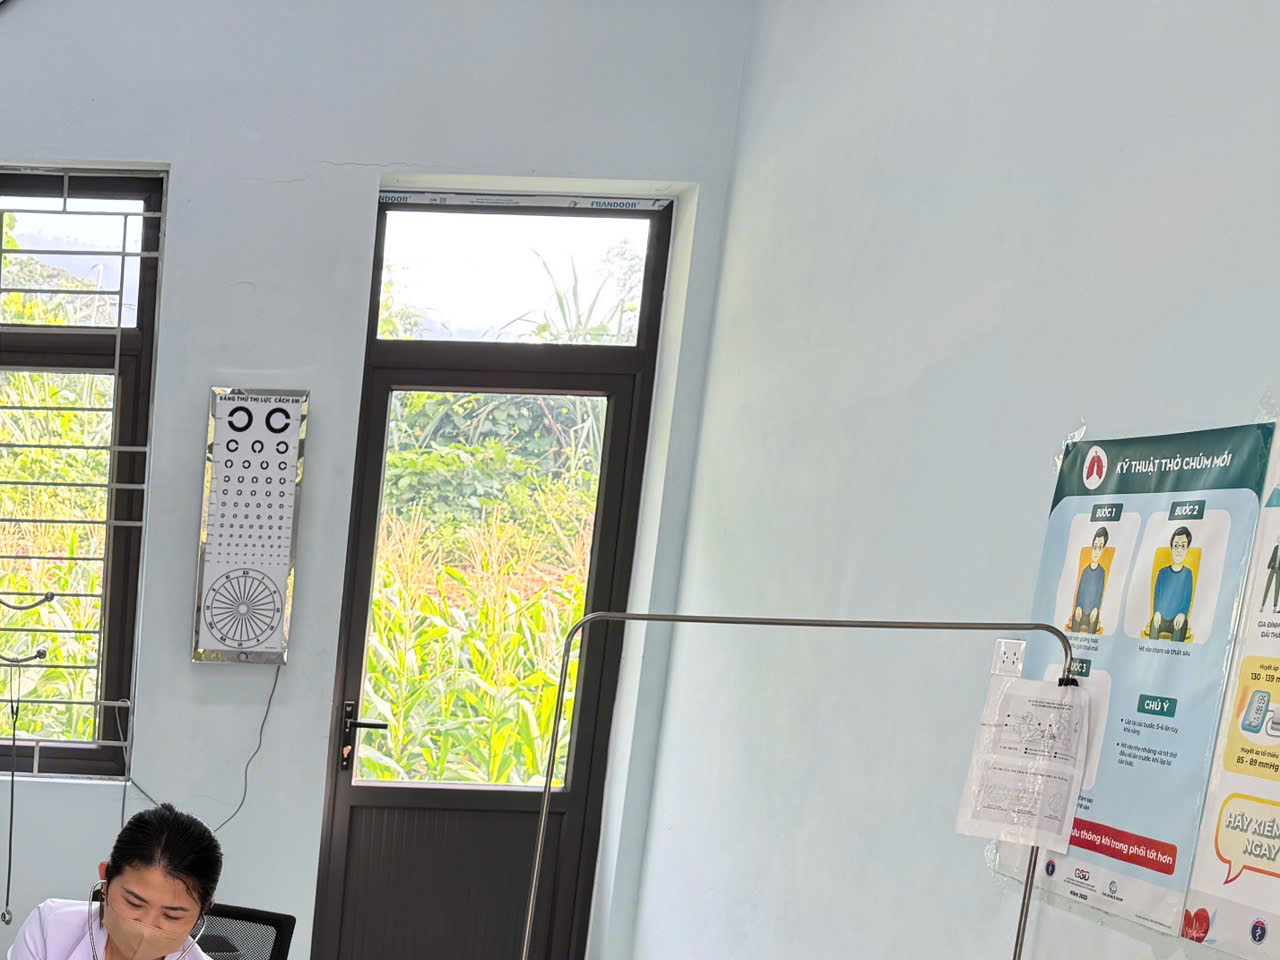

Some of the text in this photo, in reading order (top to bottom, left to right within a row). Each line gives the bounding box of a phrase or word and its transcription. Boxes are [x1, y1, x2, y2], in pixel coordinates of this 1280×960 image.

[591, 200, 637, 209] FRANDOOR
[274, 396, 290, 404] CÁCH
[1116, 458, 1130, 474] KỸ
[1131, 456, 1160, 476] THUẬT
[1161, 453, 1182, 472] THỞ
[1183, 452, 1213, 470] CHÚM
[1193, 505, 1199, 515] 2
[1070, 661, 1083, 672] ƯỚC
[1251, 672, 1261, 681] 130
[1265, 673, 1275, 683] 139
[1144, 698, 1170, 712] CHÚ Ý
[1237, 755, 1244, 764] 85
[1250, 757, 1257, 767] 89
[1258, 760, 1280, 772] mmHg
[1225, 811, 1250, 832] HÃY
[1071, 826, 1080, 837] ưu
[1080, 828, 1101, 846] thông
[1111, 837, 1128, 854] trong
[1129, 843, 1146, 857] phổi
[1147, 846, 1157, 860] tốt
[1158, 851, 1173, 865] hơn
[1243, 838, 1280, 861] NGAY
